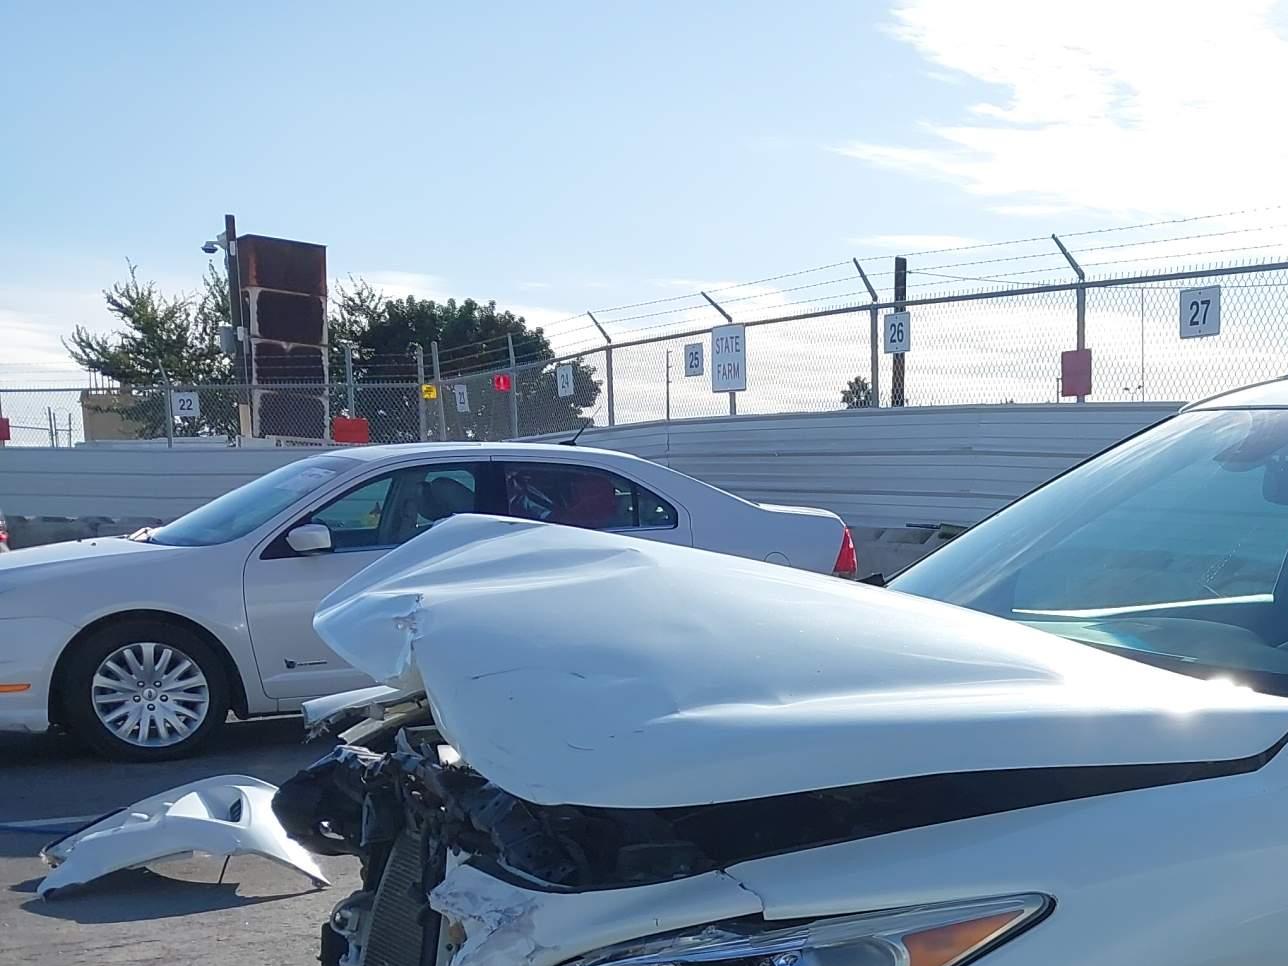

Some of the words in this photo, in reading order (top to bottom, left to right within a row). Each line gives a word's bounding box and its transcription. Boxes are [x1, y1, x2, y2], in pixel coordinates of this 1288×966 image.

[1189, 299, 1211, 326] 27
[889, 322, 904, 344] 26
[715, 335, 741, 354] STATE
[688, 351, 700, 369] 25
[560, 373, 570, 389] 24
[717, 363, 740, 381] FARM
[178, 398, 194, 411] 22
